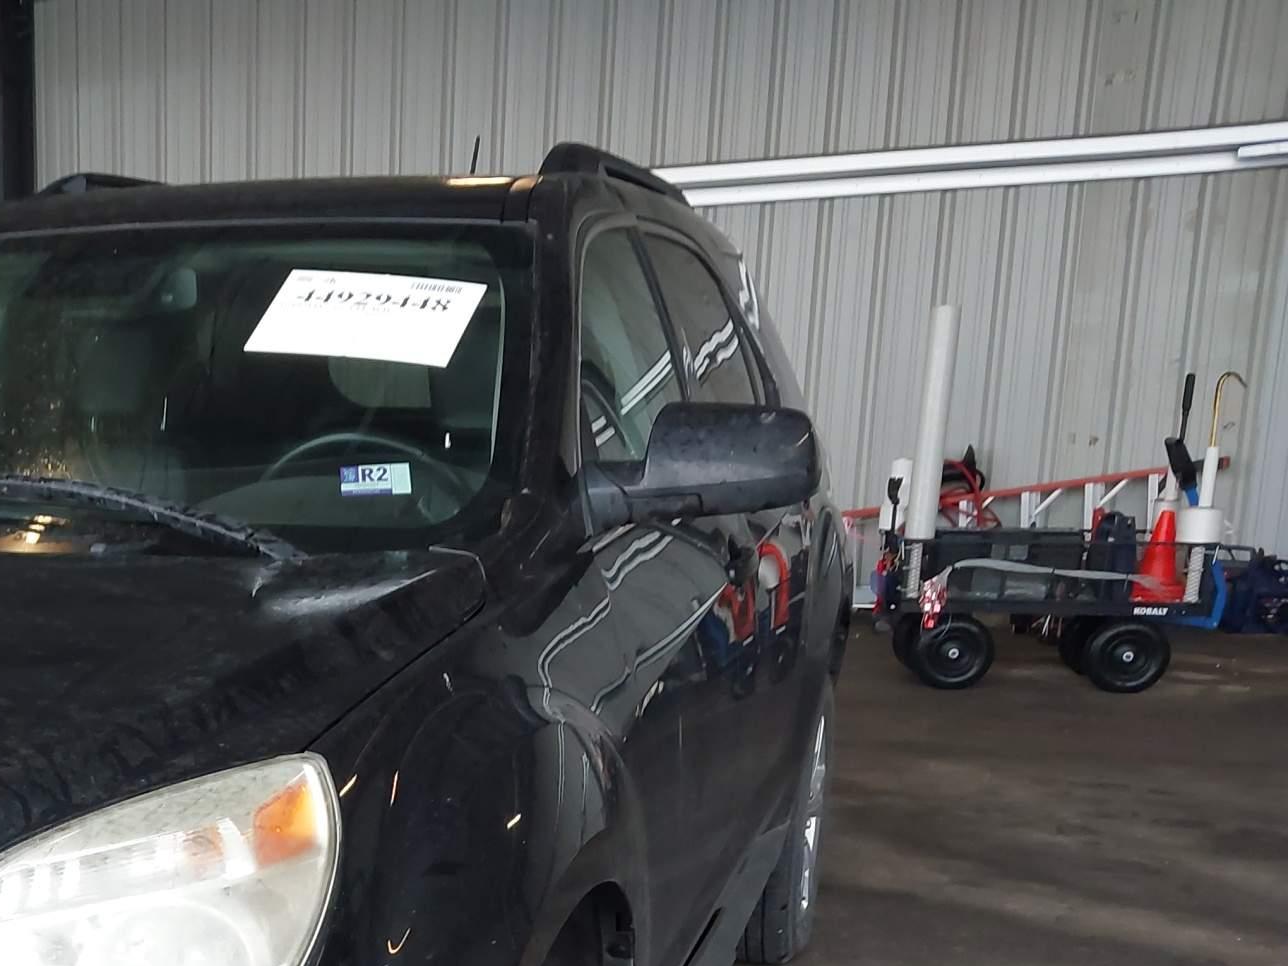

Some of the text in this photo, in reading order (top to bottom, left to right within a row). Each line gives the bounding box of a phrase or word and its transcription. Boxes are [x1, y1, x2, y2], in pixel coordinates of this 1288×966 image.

[297, 289, 451, 312] 44929448
[360, 466, 389, 482] R2
[1133, 606, 1169, 616] KOBALT
